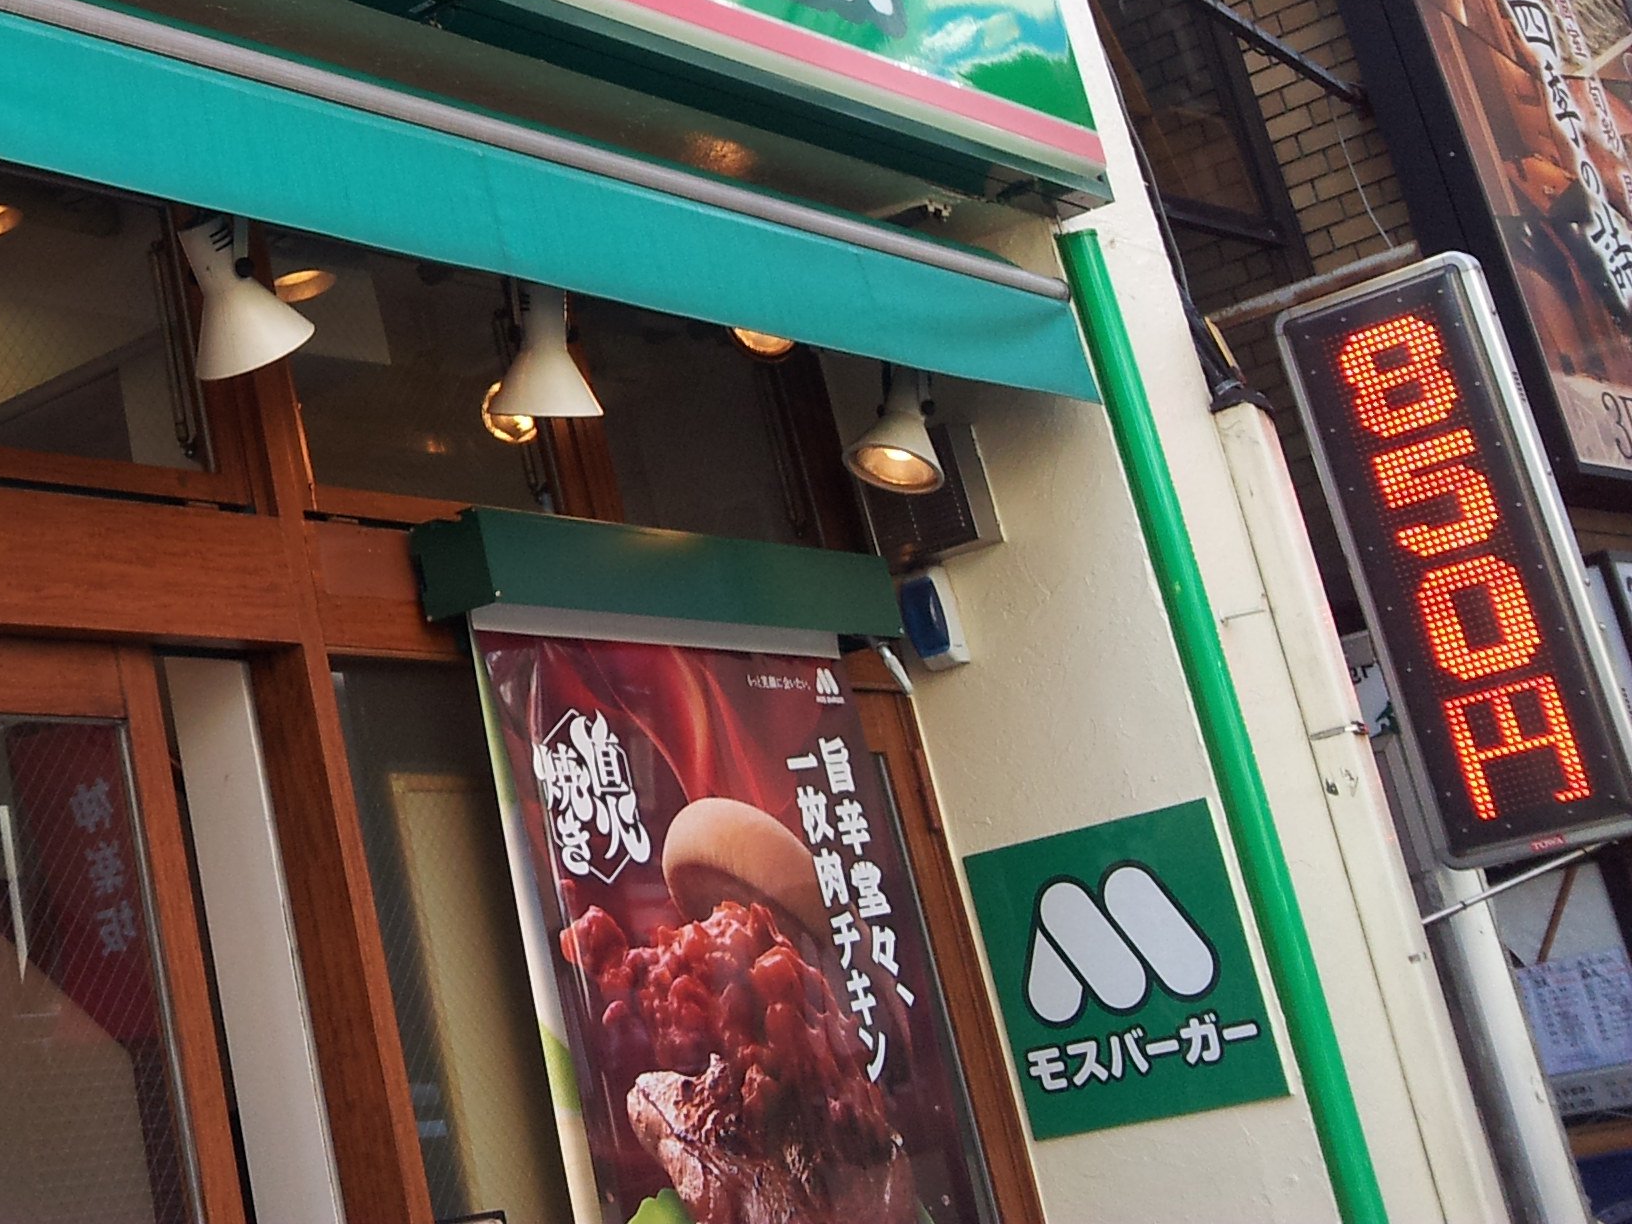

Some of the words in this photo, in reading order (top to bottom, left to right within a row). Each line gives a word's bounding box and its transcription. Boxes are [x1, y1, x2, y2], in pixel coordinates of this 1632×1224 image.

[1338, 313, 1592, 822] 850円
[533, 742, 590, 876] 焼き
[570, 708, 651, 864] 直火
[786, 753, 887, 1083] 一枚肉チキン
[1026, 1011, 1259, 1092] モスバーガー
